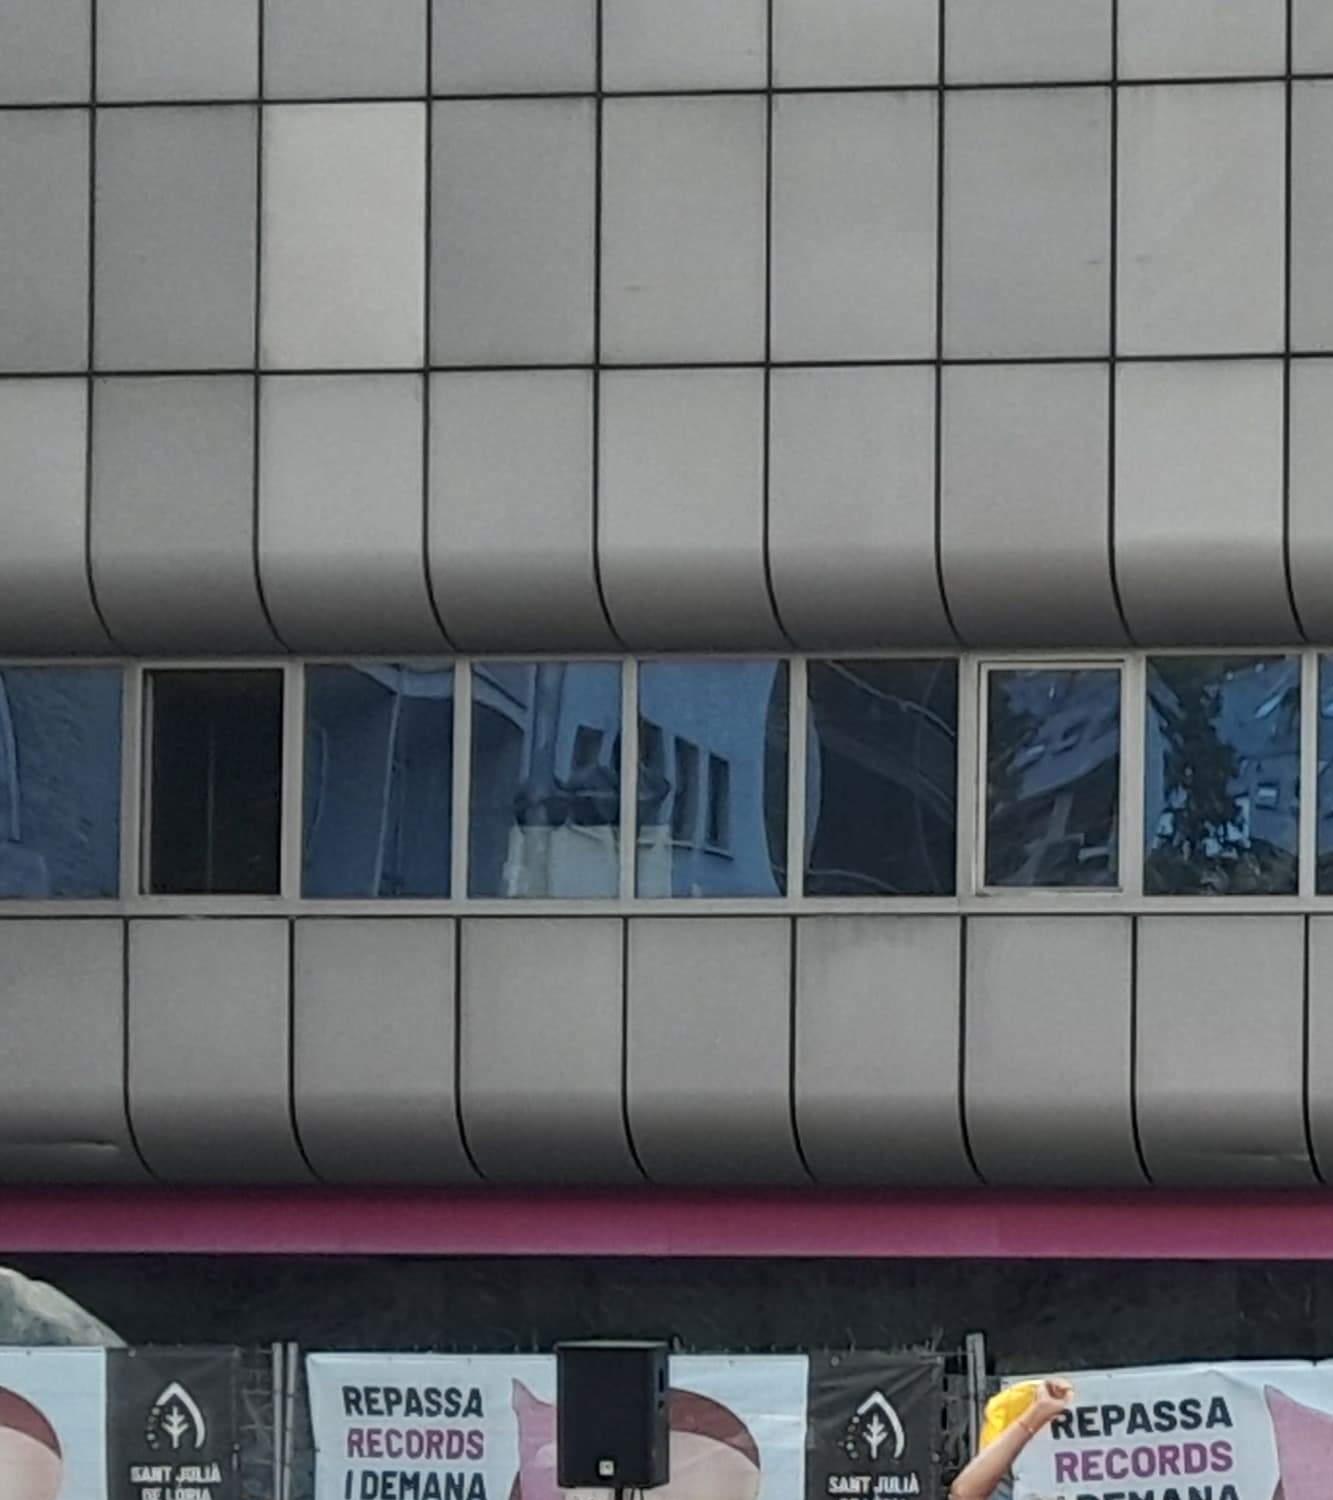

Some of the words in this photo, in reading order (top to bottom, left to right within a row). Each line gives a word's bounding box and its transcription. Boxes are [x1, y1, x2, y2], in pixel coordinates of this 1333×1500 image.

[342, 1385, 484, 1418] REPASSA
[1051, 1396, 1233, 1440] REPASSA
[347, 1428, 484, 1460] RECORDS
[131, 1466, 172, 1483] SANT
[1054, 1440, 1233, 1483] RECORDS
[345, 1470, 354, 1500] I
[829, 1475, 871, 1493] SANT
[873, 1473, 919, 1493] JULIÀ
